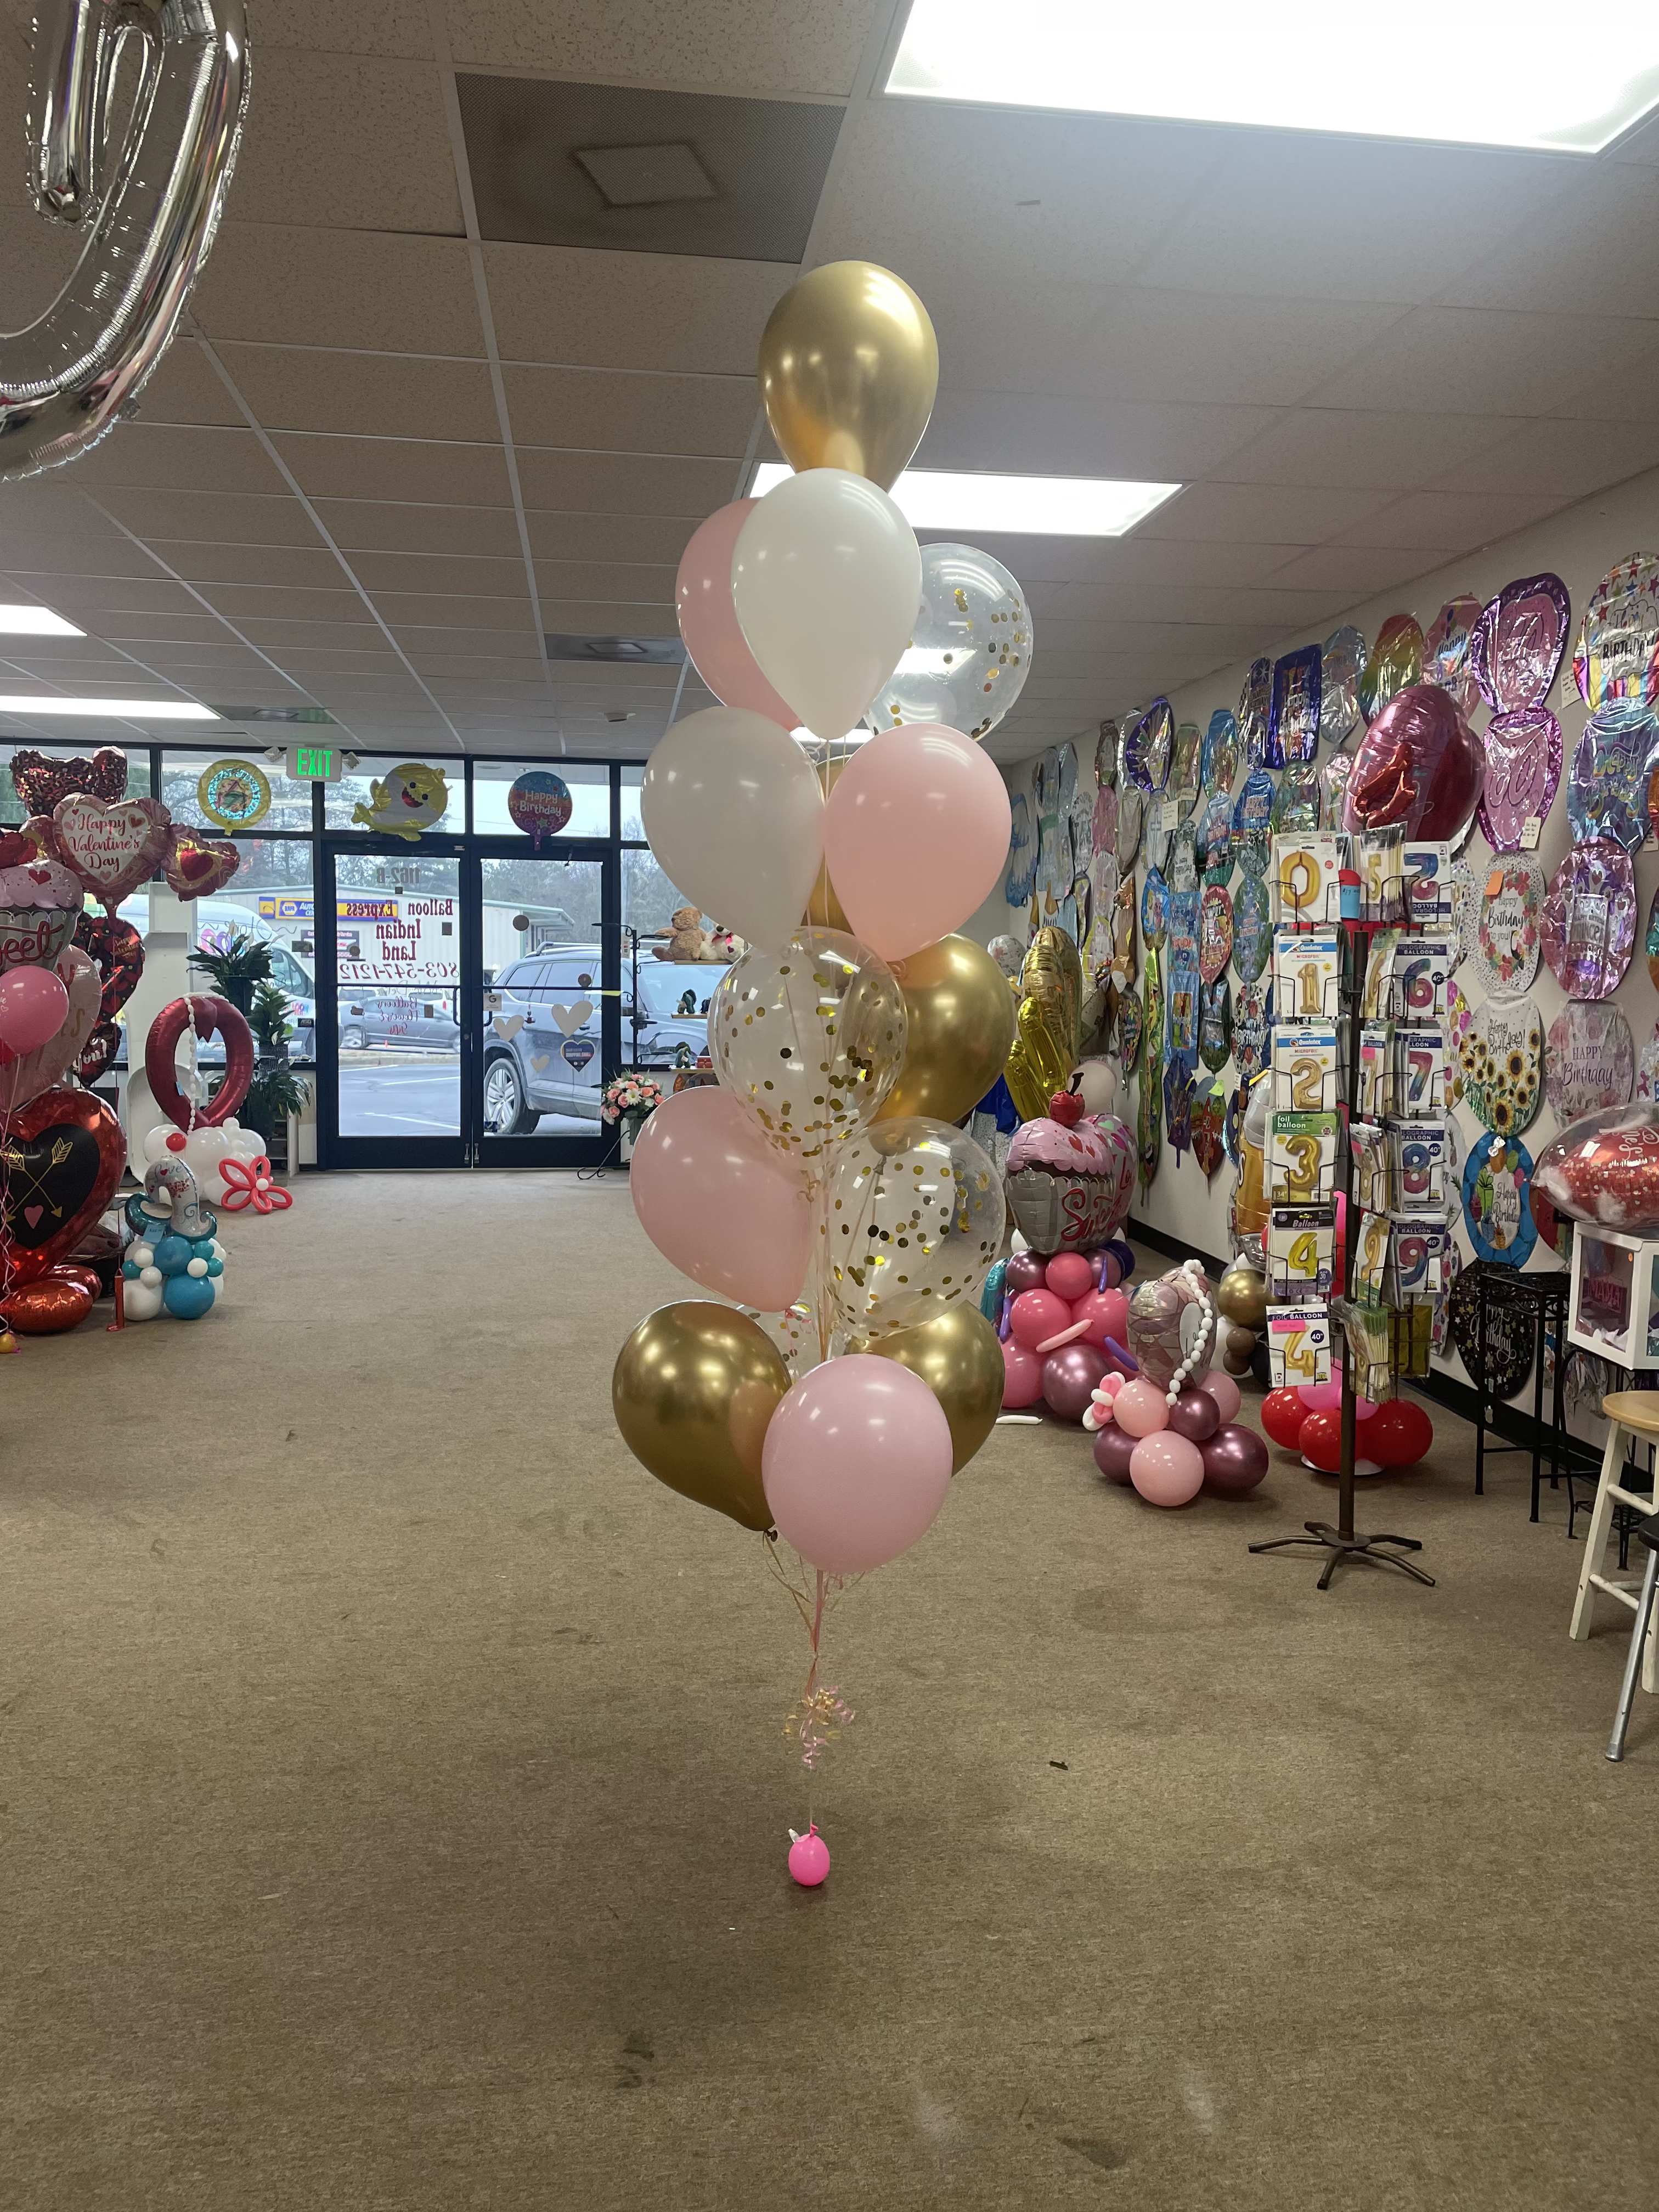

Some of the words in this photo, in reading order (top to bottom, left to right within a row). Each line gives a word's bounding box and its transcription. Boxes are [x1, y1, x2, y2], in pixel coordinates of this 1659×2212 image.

[297, 748, 332, 777] EXIT
[525, 789, 558, 804] Happy
[519, 800, 562, 817] Birthday
[77, 813, 126, 836] Happy
[68, 833, 140, 852] Valentine's
[84, 852, 120, 872] Day
[1488, 907, 1523, 930] Birthday
[489, 995, 496, 1003] G
[1487, 1019, 1508, 1038] Happy
[1572, 1047, 1604, 1060] HAPPY
[1563, 1062, 1614, 1091] Birthday
[1277, 1115, 1290, 1123] foil
[1293, 1219, 1319, 1228] Balloon
